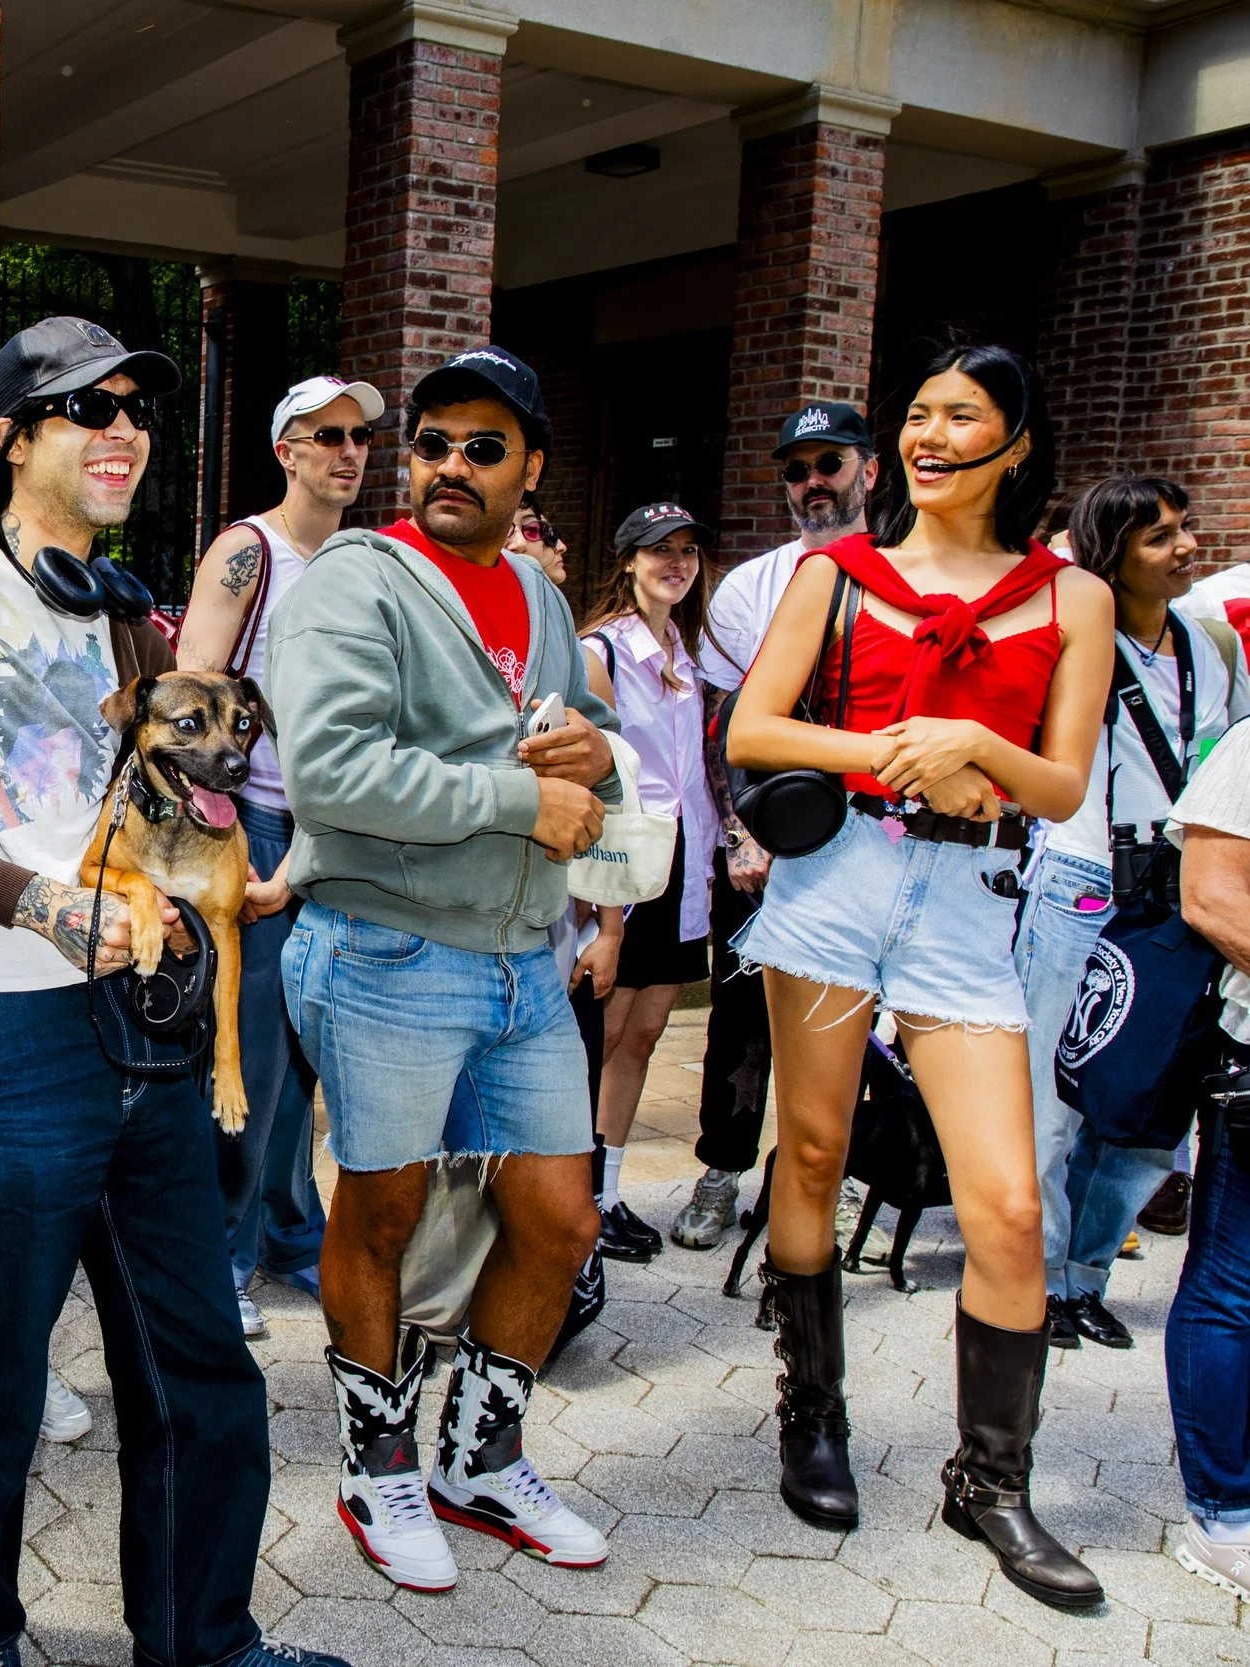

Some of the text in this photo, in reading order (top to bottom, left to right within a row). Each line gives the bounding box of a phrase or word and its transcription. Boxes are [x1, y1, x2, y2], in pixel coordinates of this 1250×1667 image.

[1089, 944, 1126, 1049] Society of New York City
